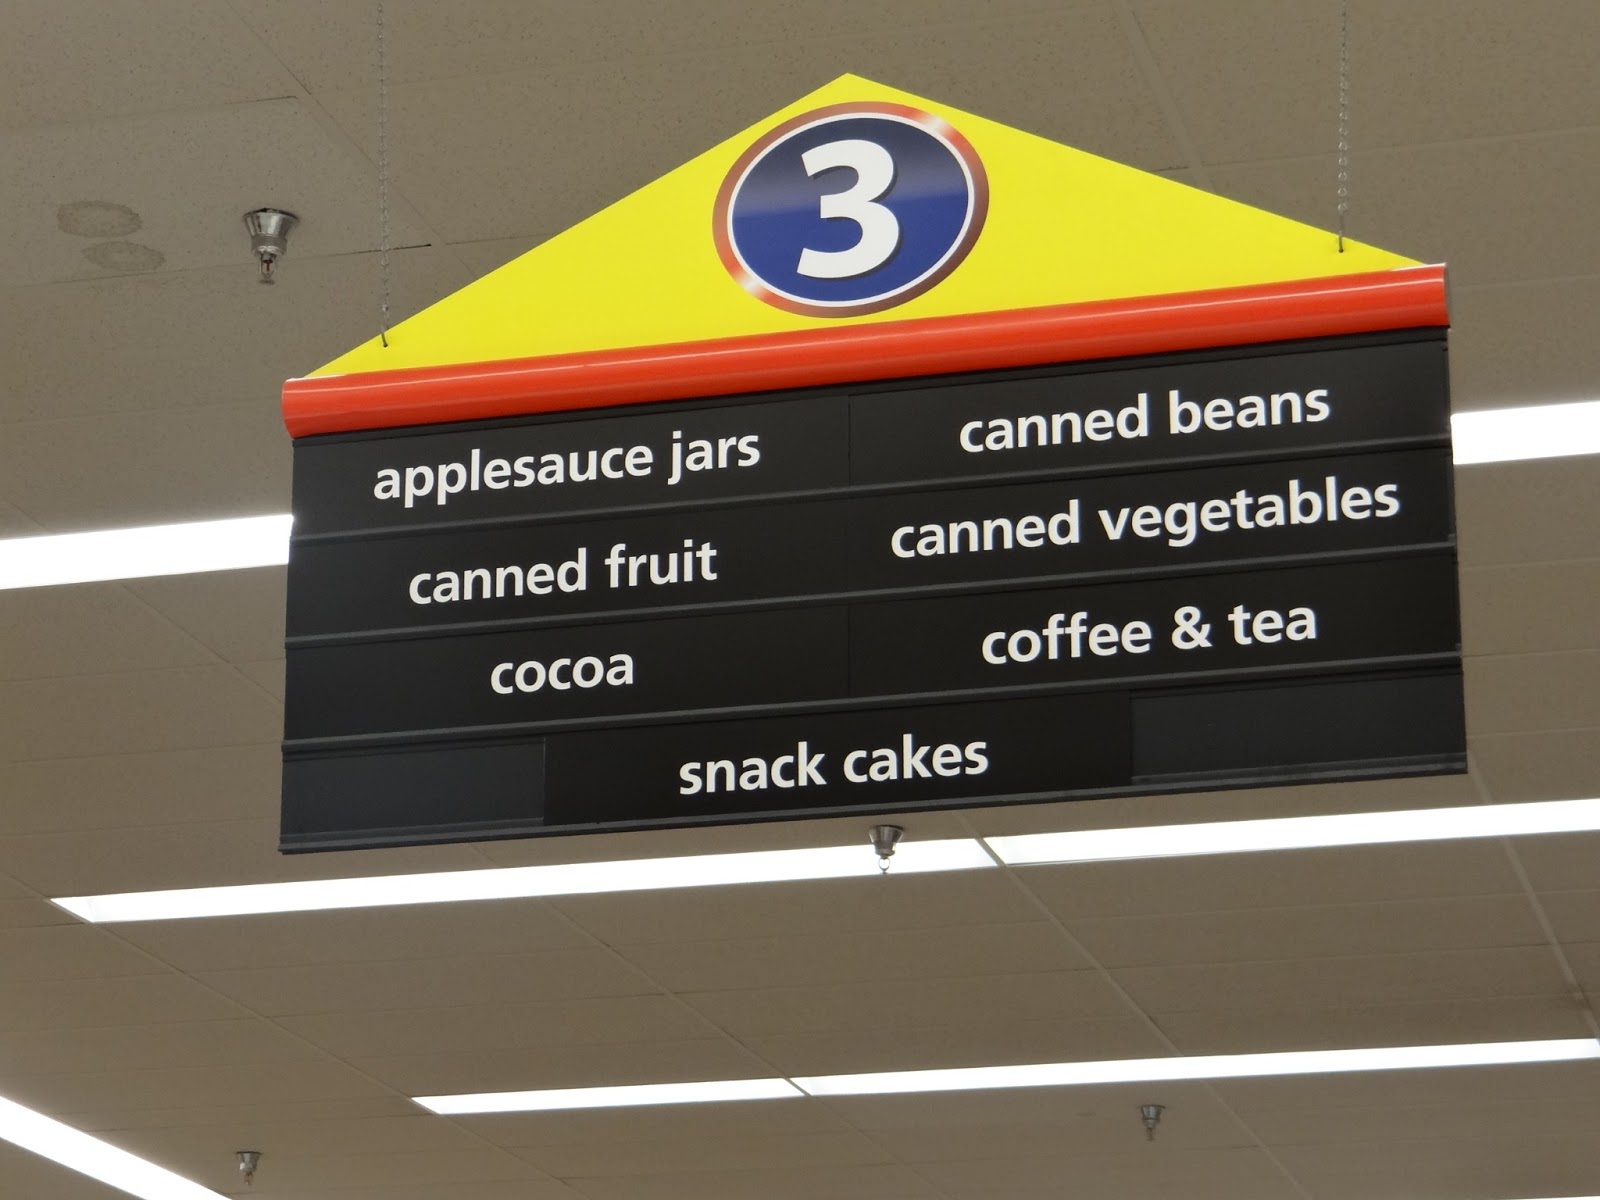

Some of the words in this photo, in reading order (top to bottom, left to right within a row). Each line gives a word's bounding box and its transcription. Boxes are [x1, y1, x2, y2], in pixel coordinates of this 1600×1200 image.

[797, 139, 899, 278] 3
[960, 392, 1149, 453] canned
[1169, 388, 1330, 434] beans
[374, 446, 653, 508] applesauce
[667, 430, 761, 485] jars
[891, 499, 1080, 557] canned
[1100, 475, 1399, 549] vegetables
[409, 548, 587, 604] canned
[605, 539, 718, 588] fruit
[982, 612, 1151, 665] coffee
[1172, 606, 1212, 649] &
[1228, 604, 1318, 646] tea
[491, 653, 634, 694] cocoa
[679, 741, 826, 795] snack
[844, 733, 989, 783] cakes
